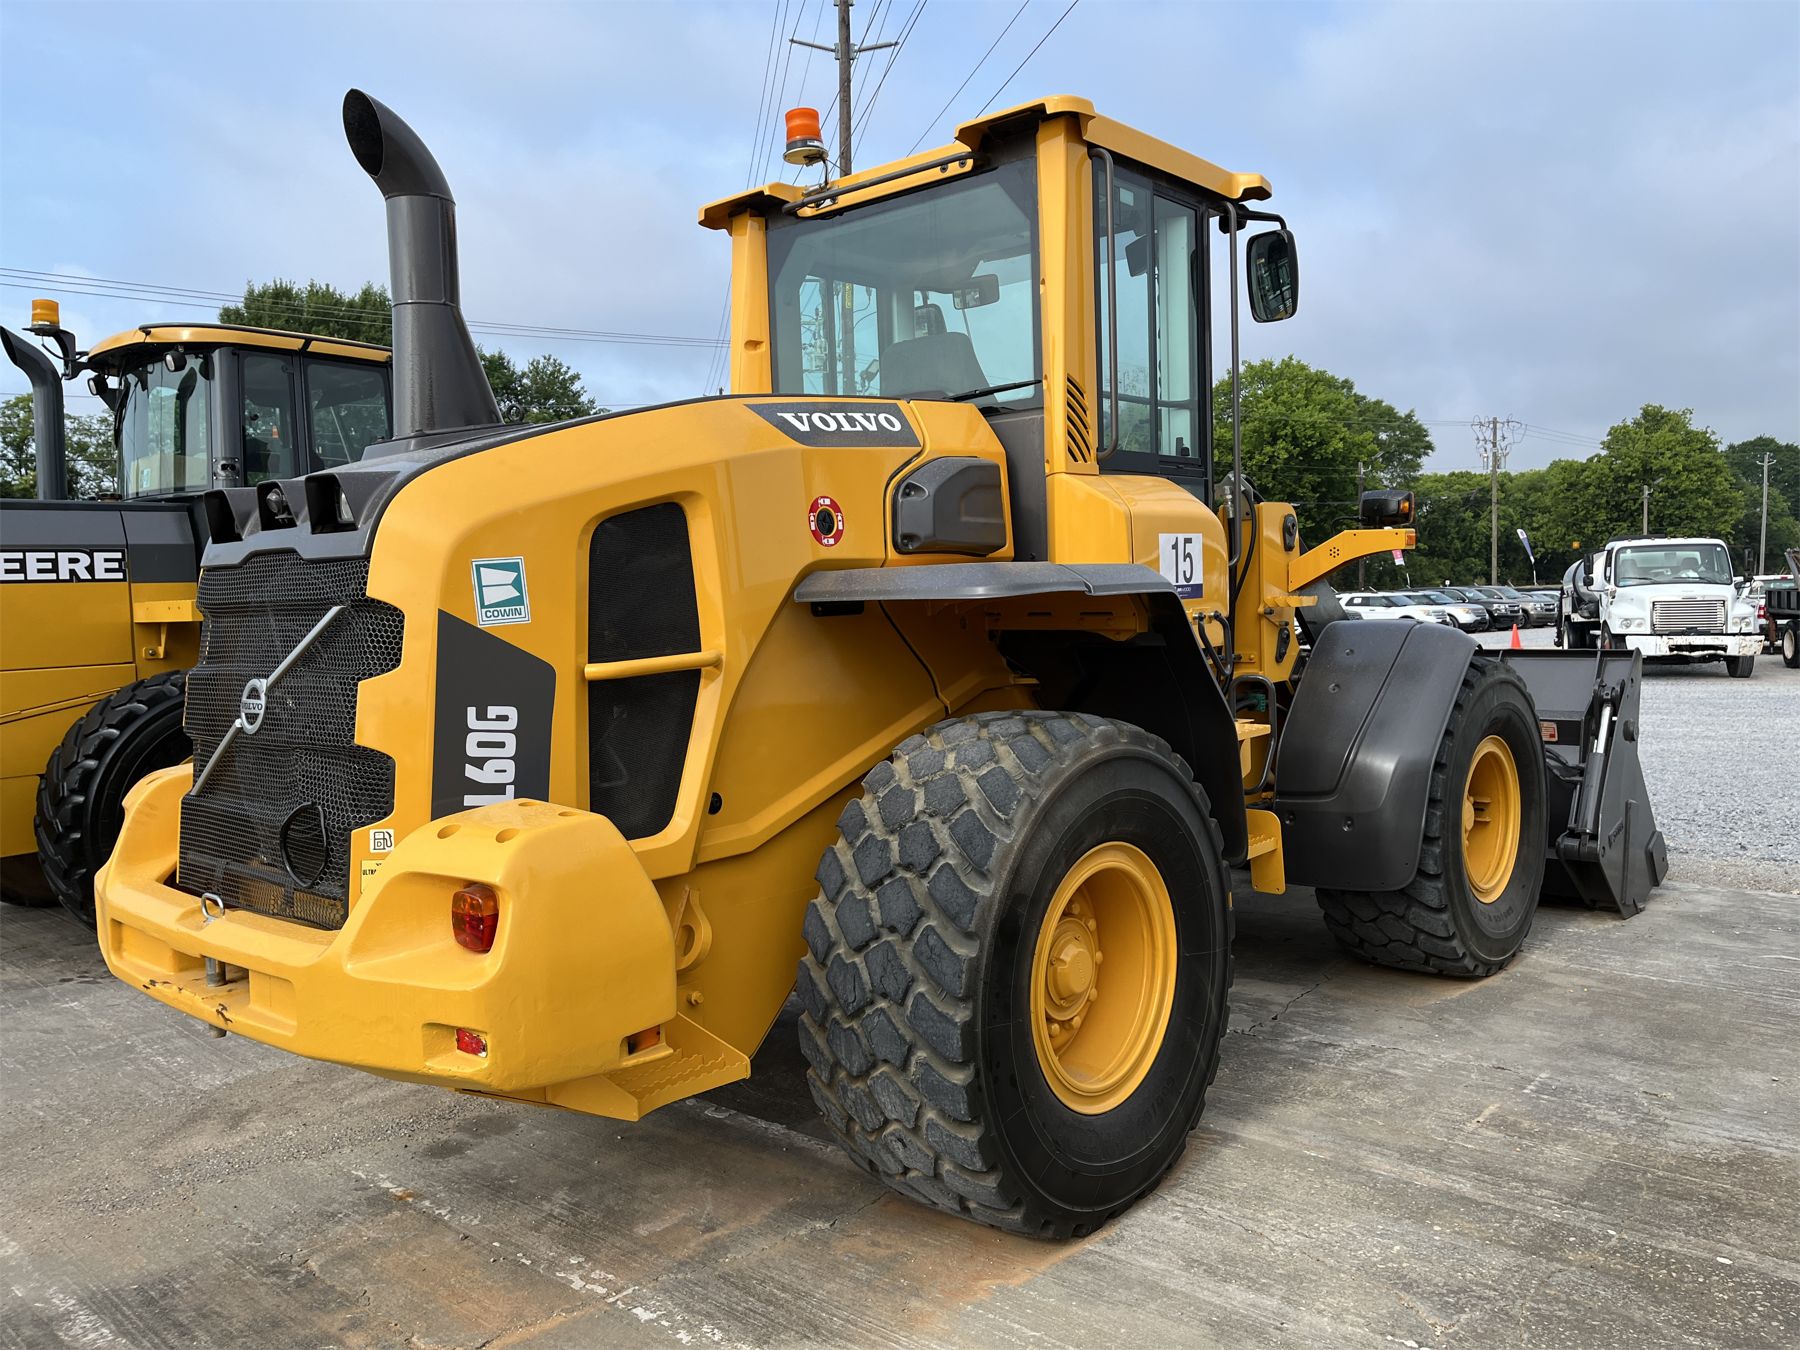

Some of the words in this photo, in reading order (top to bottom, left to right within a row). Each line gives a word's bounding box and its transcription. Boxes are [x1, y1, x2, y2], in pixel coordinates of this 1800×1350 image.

[777, 412, 902, 432] VOLVO
[0, 551, 124, 581] EERE
[1171, 536, 1194, 584] 15
[484, 607, 522, 619] COWIN
[463, 705, 518, 807] L60G
